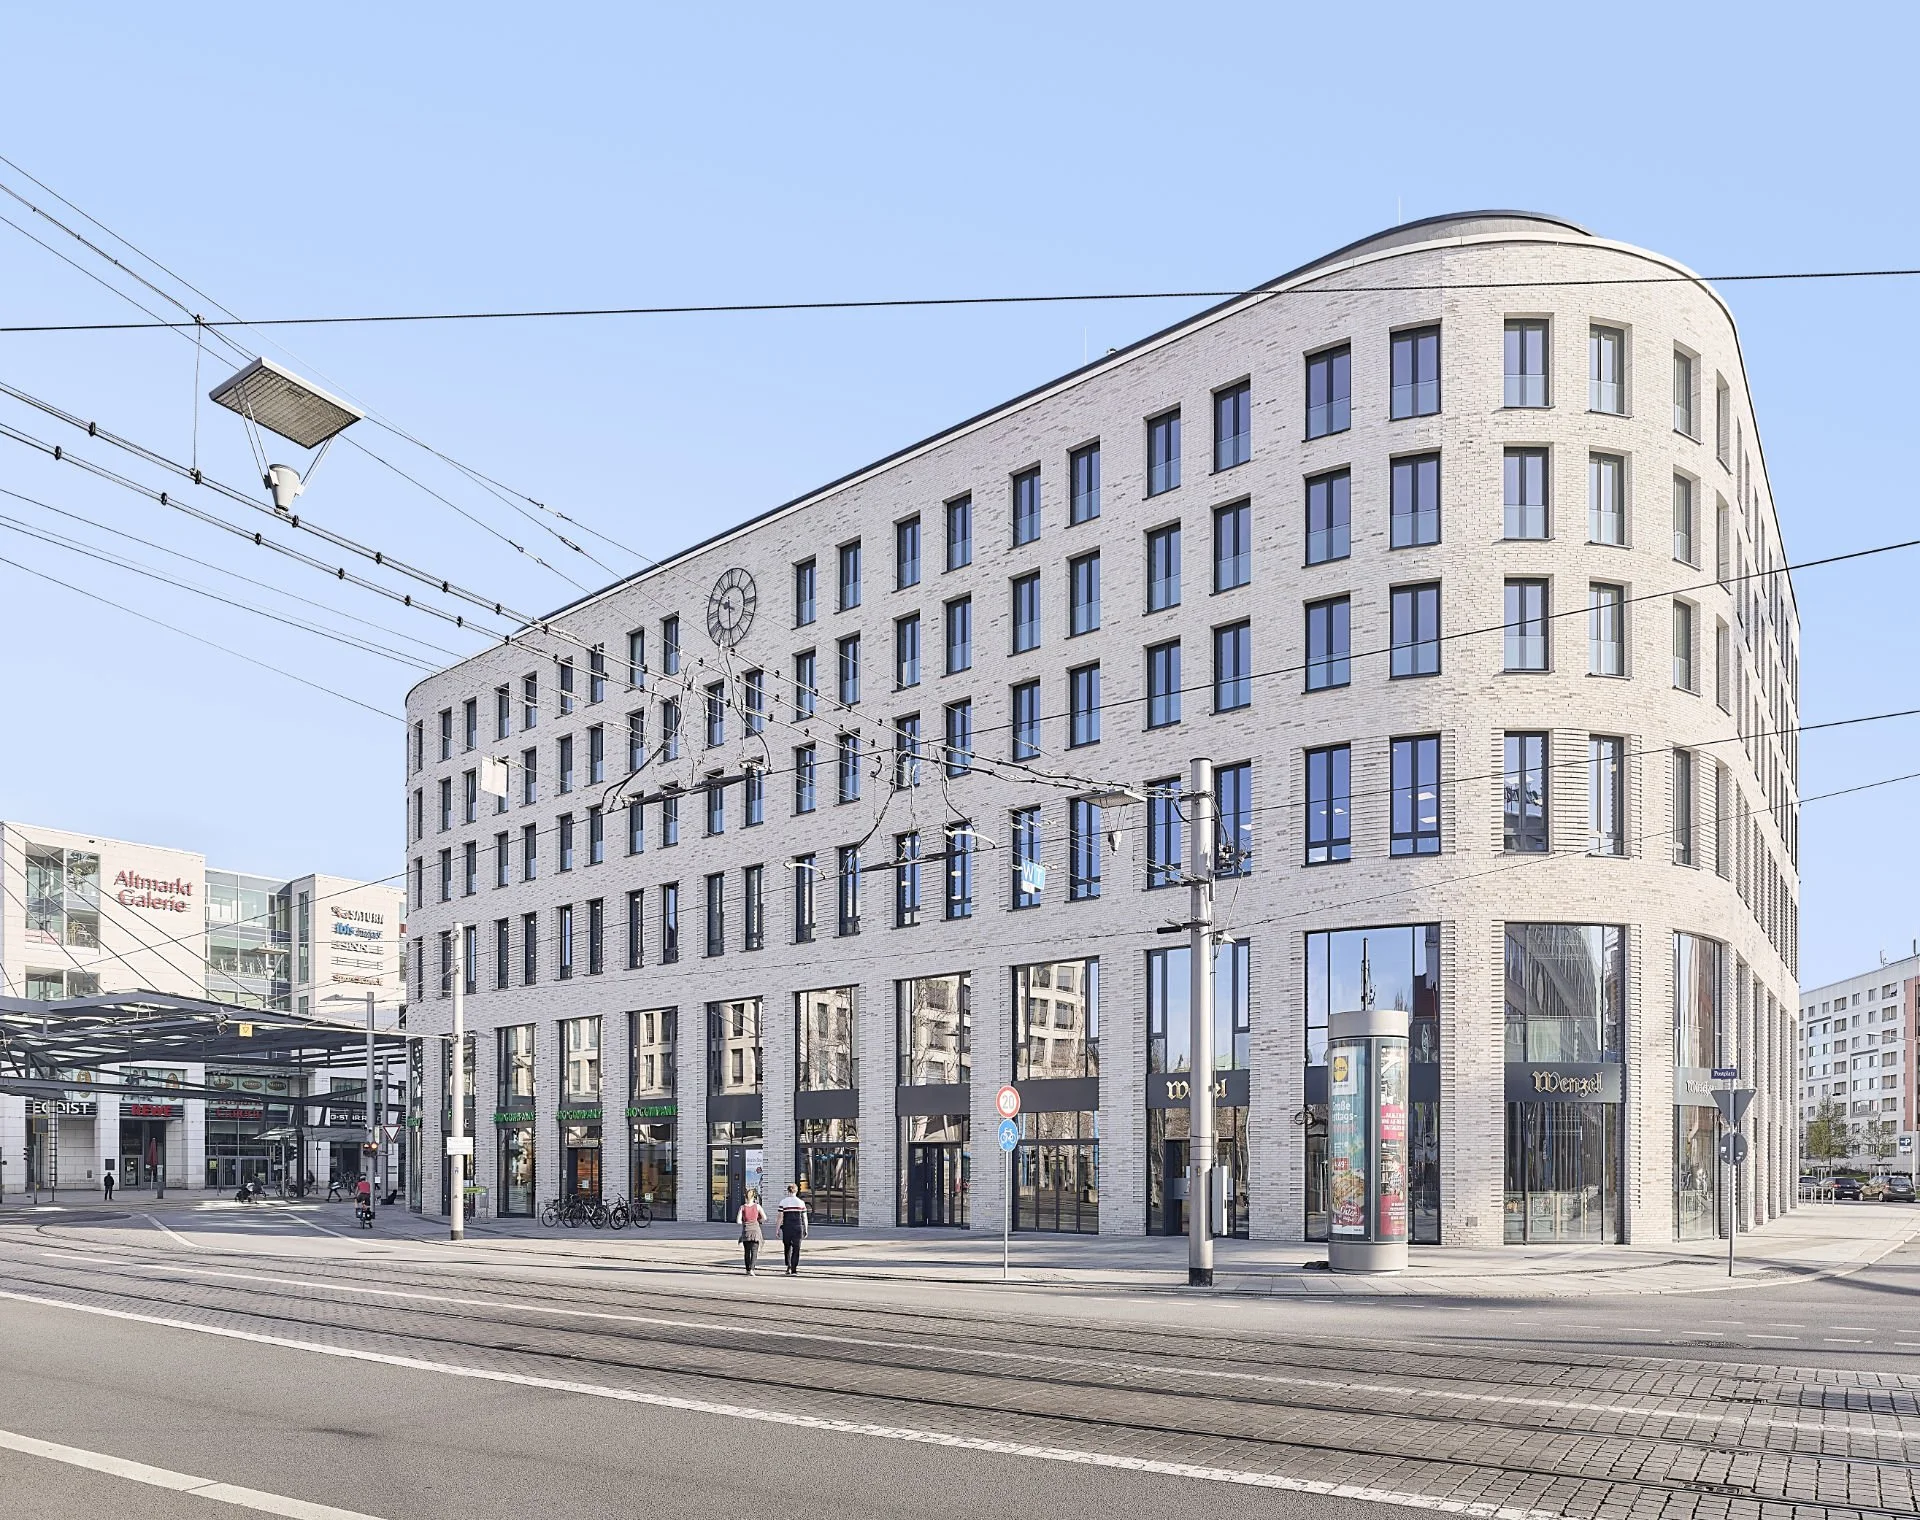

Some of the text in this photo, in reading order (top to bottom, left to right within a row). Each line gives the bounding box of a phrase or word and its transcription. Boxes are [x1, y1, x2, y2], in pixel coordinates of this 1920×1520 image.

[114, 870, 193, 896] Altmarkt
[117, 889, 188, 913] Galerie
[1532, 1071, 1603, 1098] Wenzel
[131, 1104, 173, 1117] REWE
[1002, 1095, 1015, 1109] 20
